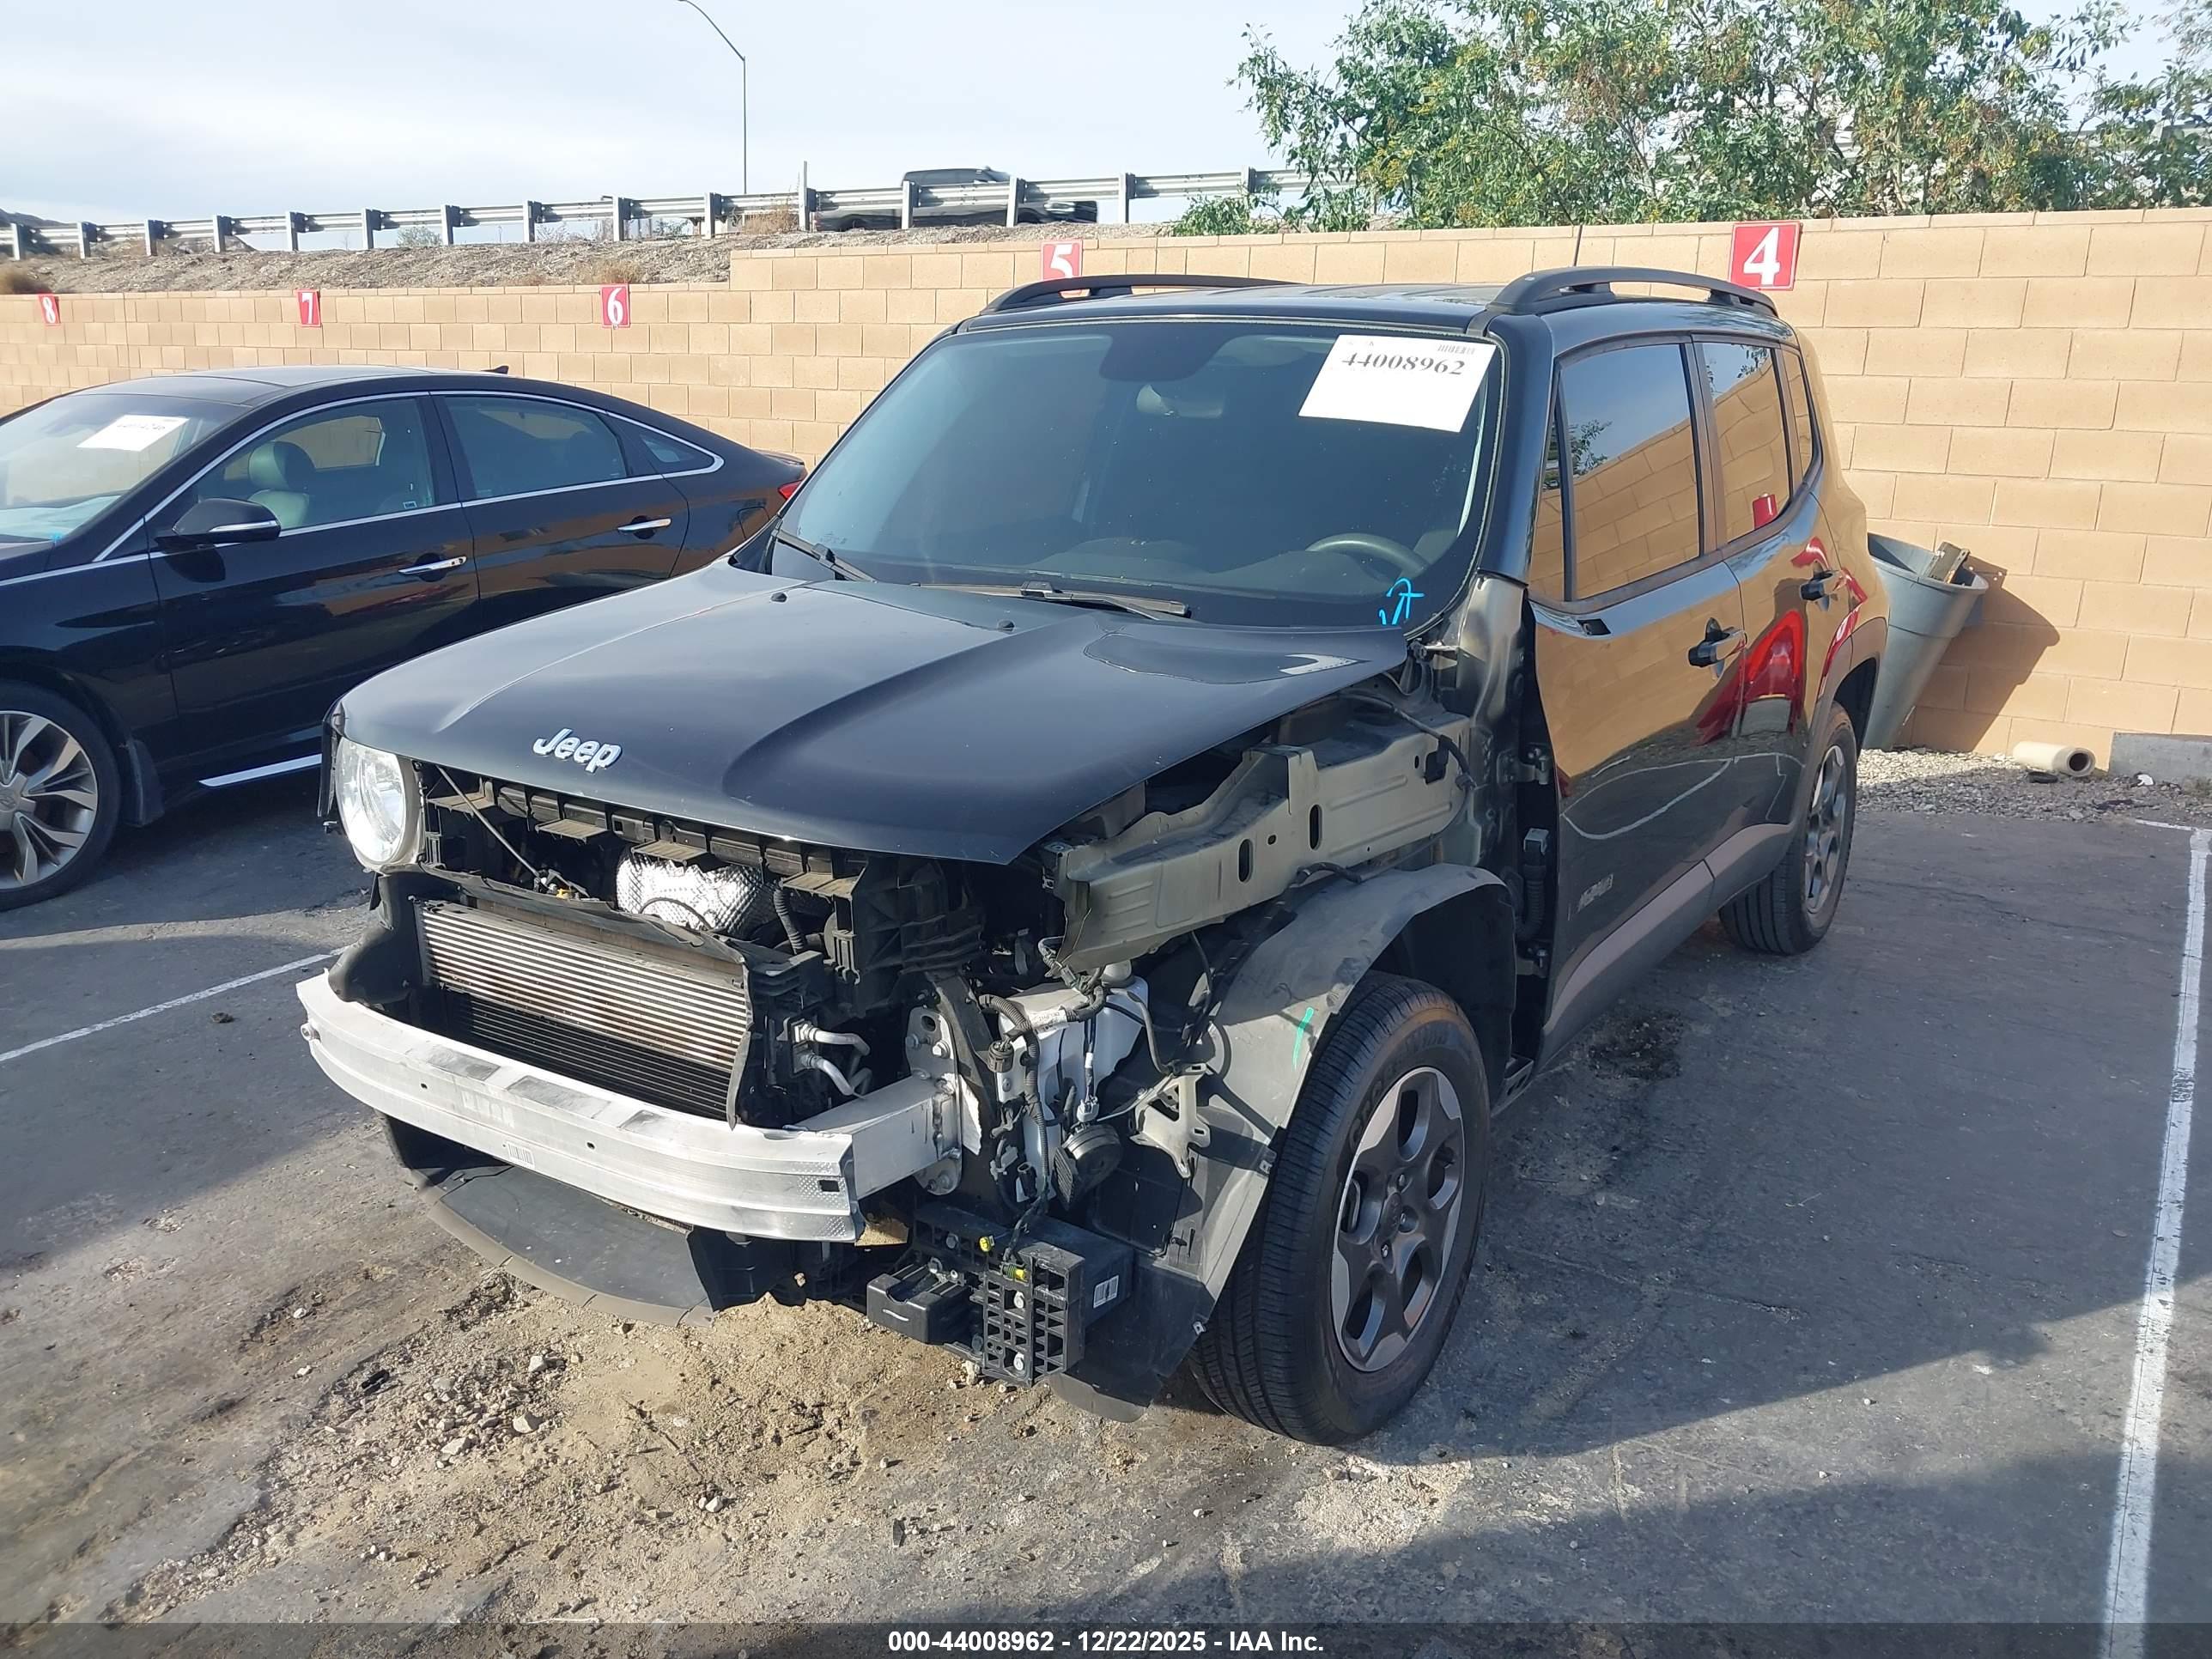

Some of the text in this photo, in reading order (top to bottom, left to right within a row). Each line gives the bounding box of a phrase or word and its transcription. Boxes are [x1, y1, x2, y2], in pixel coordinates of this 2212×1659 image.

[1050, 244, 1073, 278] 5
[1743, 226, 1780, 285] 4
[43, 296, 56, 324] 8
[301, 292, 313, 324] 7
[608, 287, 623, 325] 6
[1341, 352, 1465, 375] 44008962
[532, 728, 623, 773] Jeep
